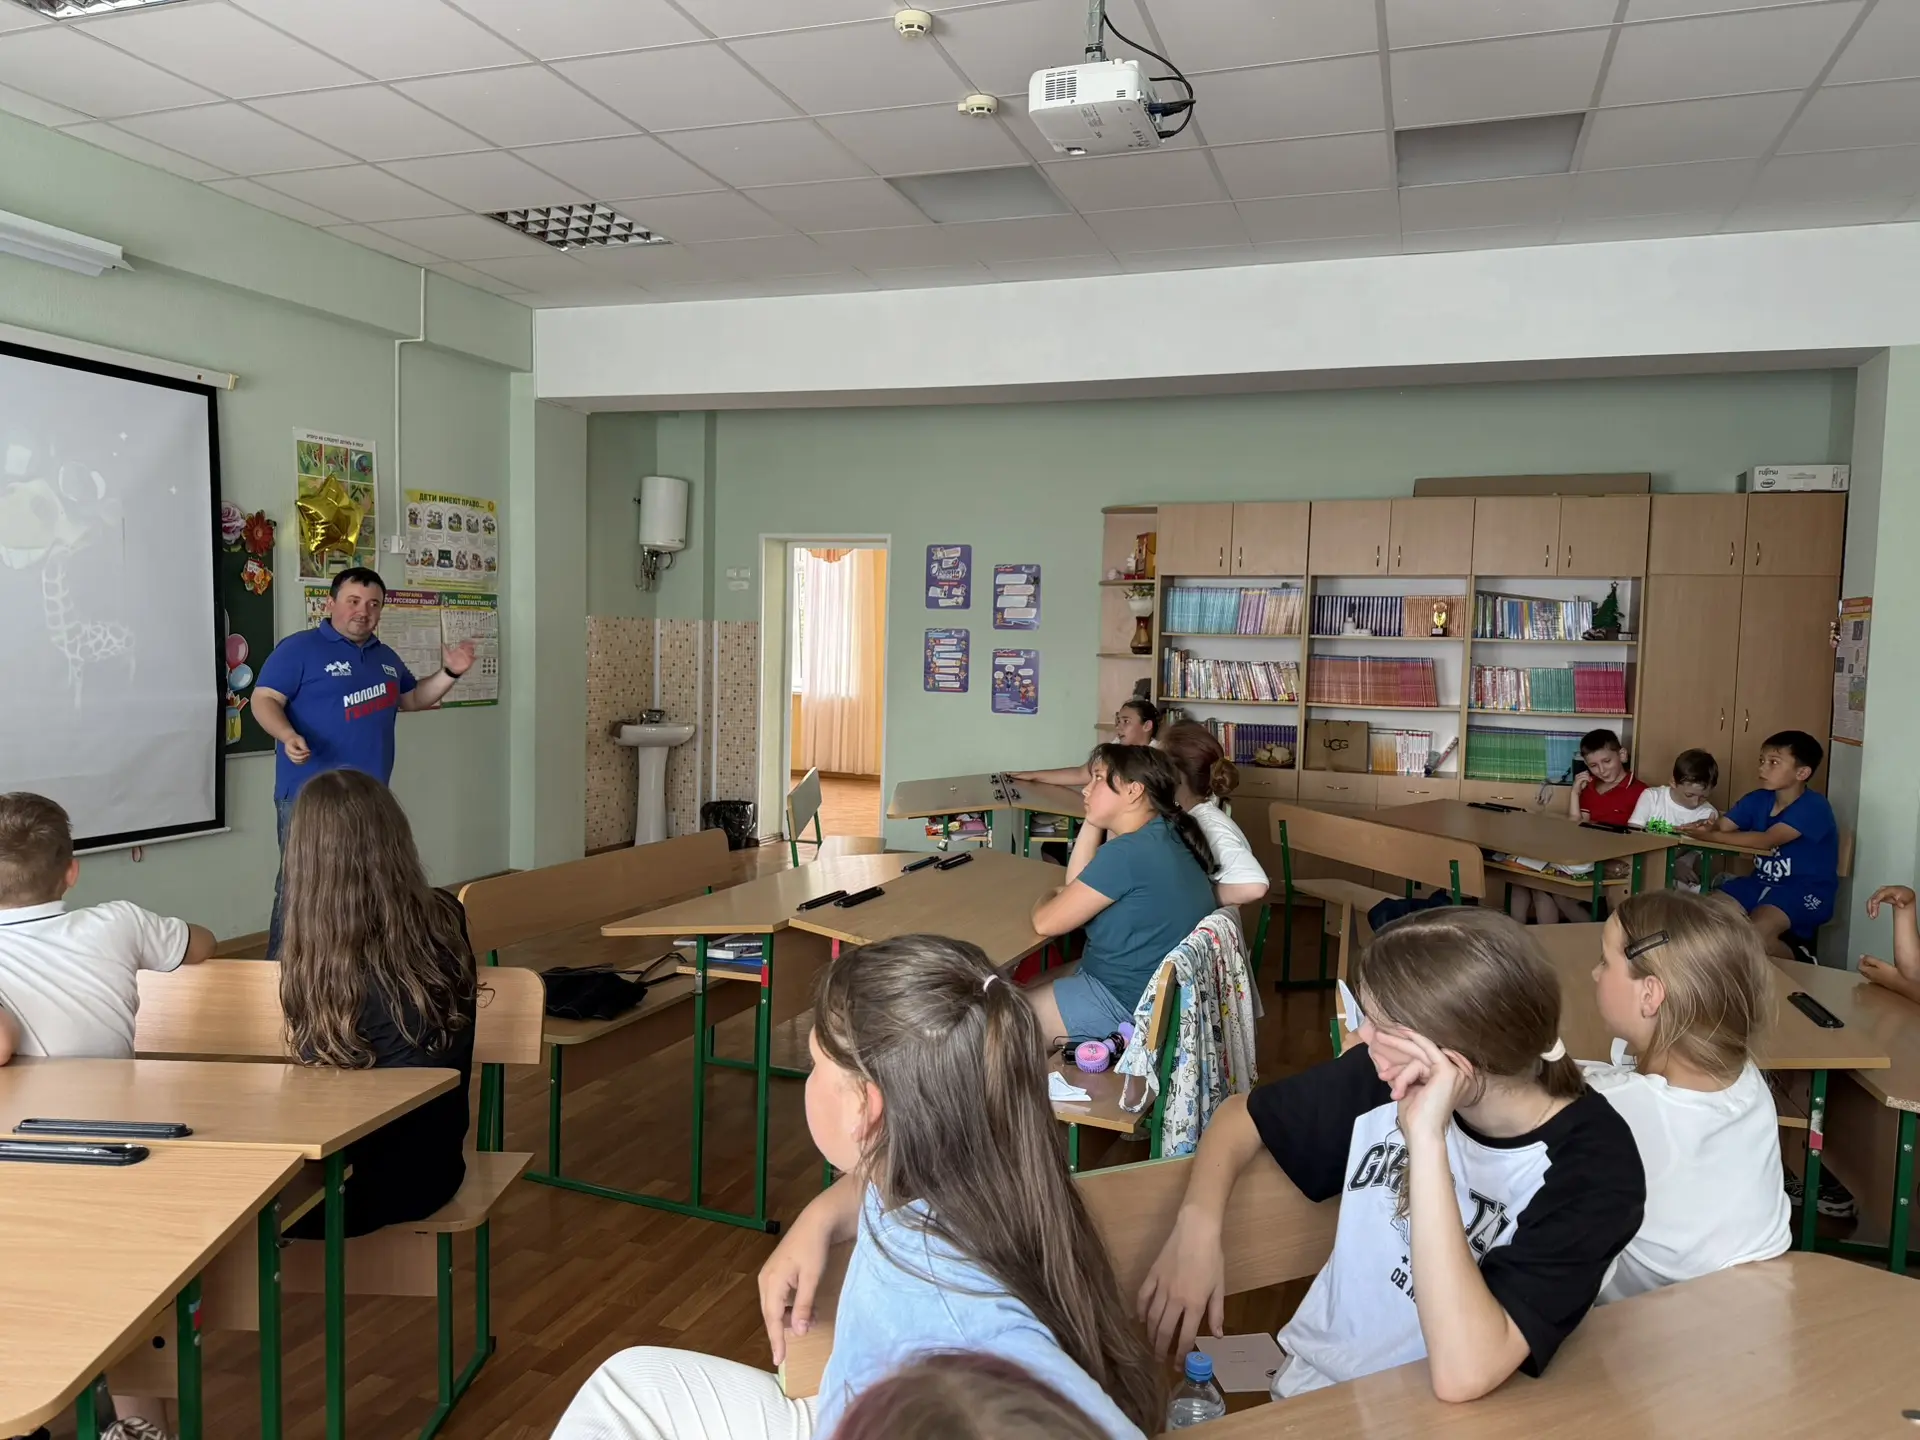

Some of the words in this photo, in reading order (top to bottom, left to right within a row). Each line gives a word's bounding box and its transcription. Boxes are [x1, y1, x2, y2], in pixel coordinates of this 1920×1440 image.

[1758, 467, 1779, 476] FUJITSU
[418, 492, 437, 502] ДЕТИ
[438, 495, 460, 505] ИМЕЮТ
[393, 597, 419, 605] РУССКОМУ
[1323, 739, 1349, 751] UGG
